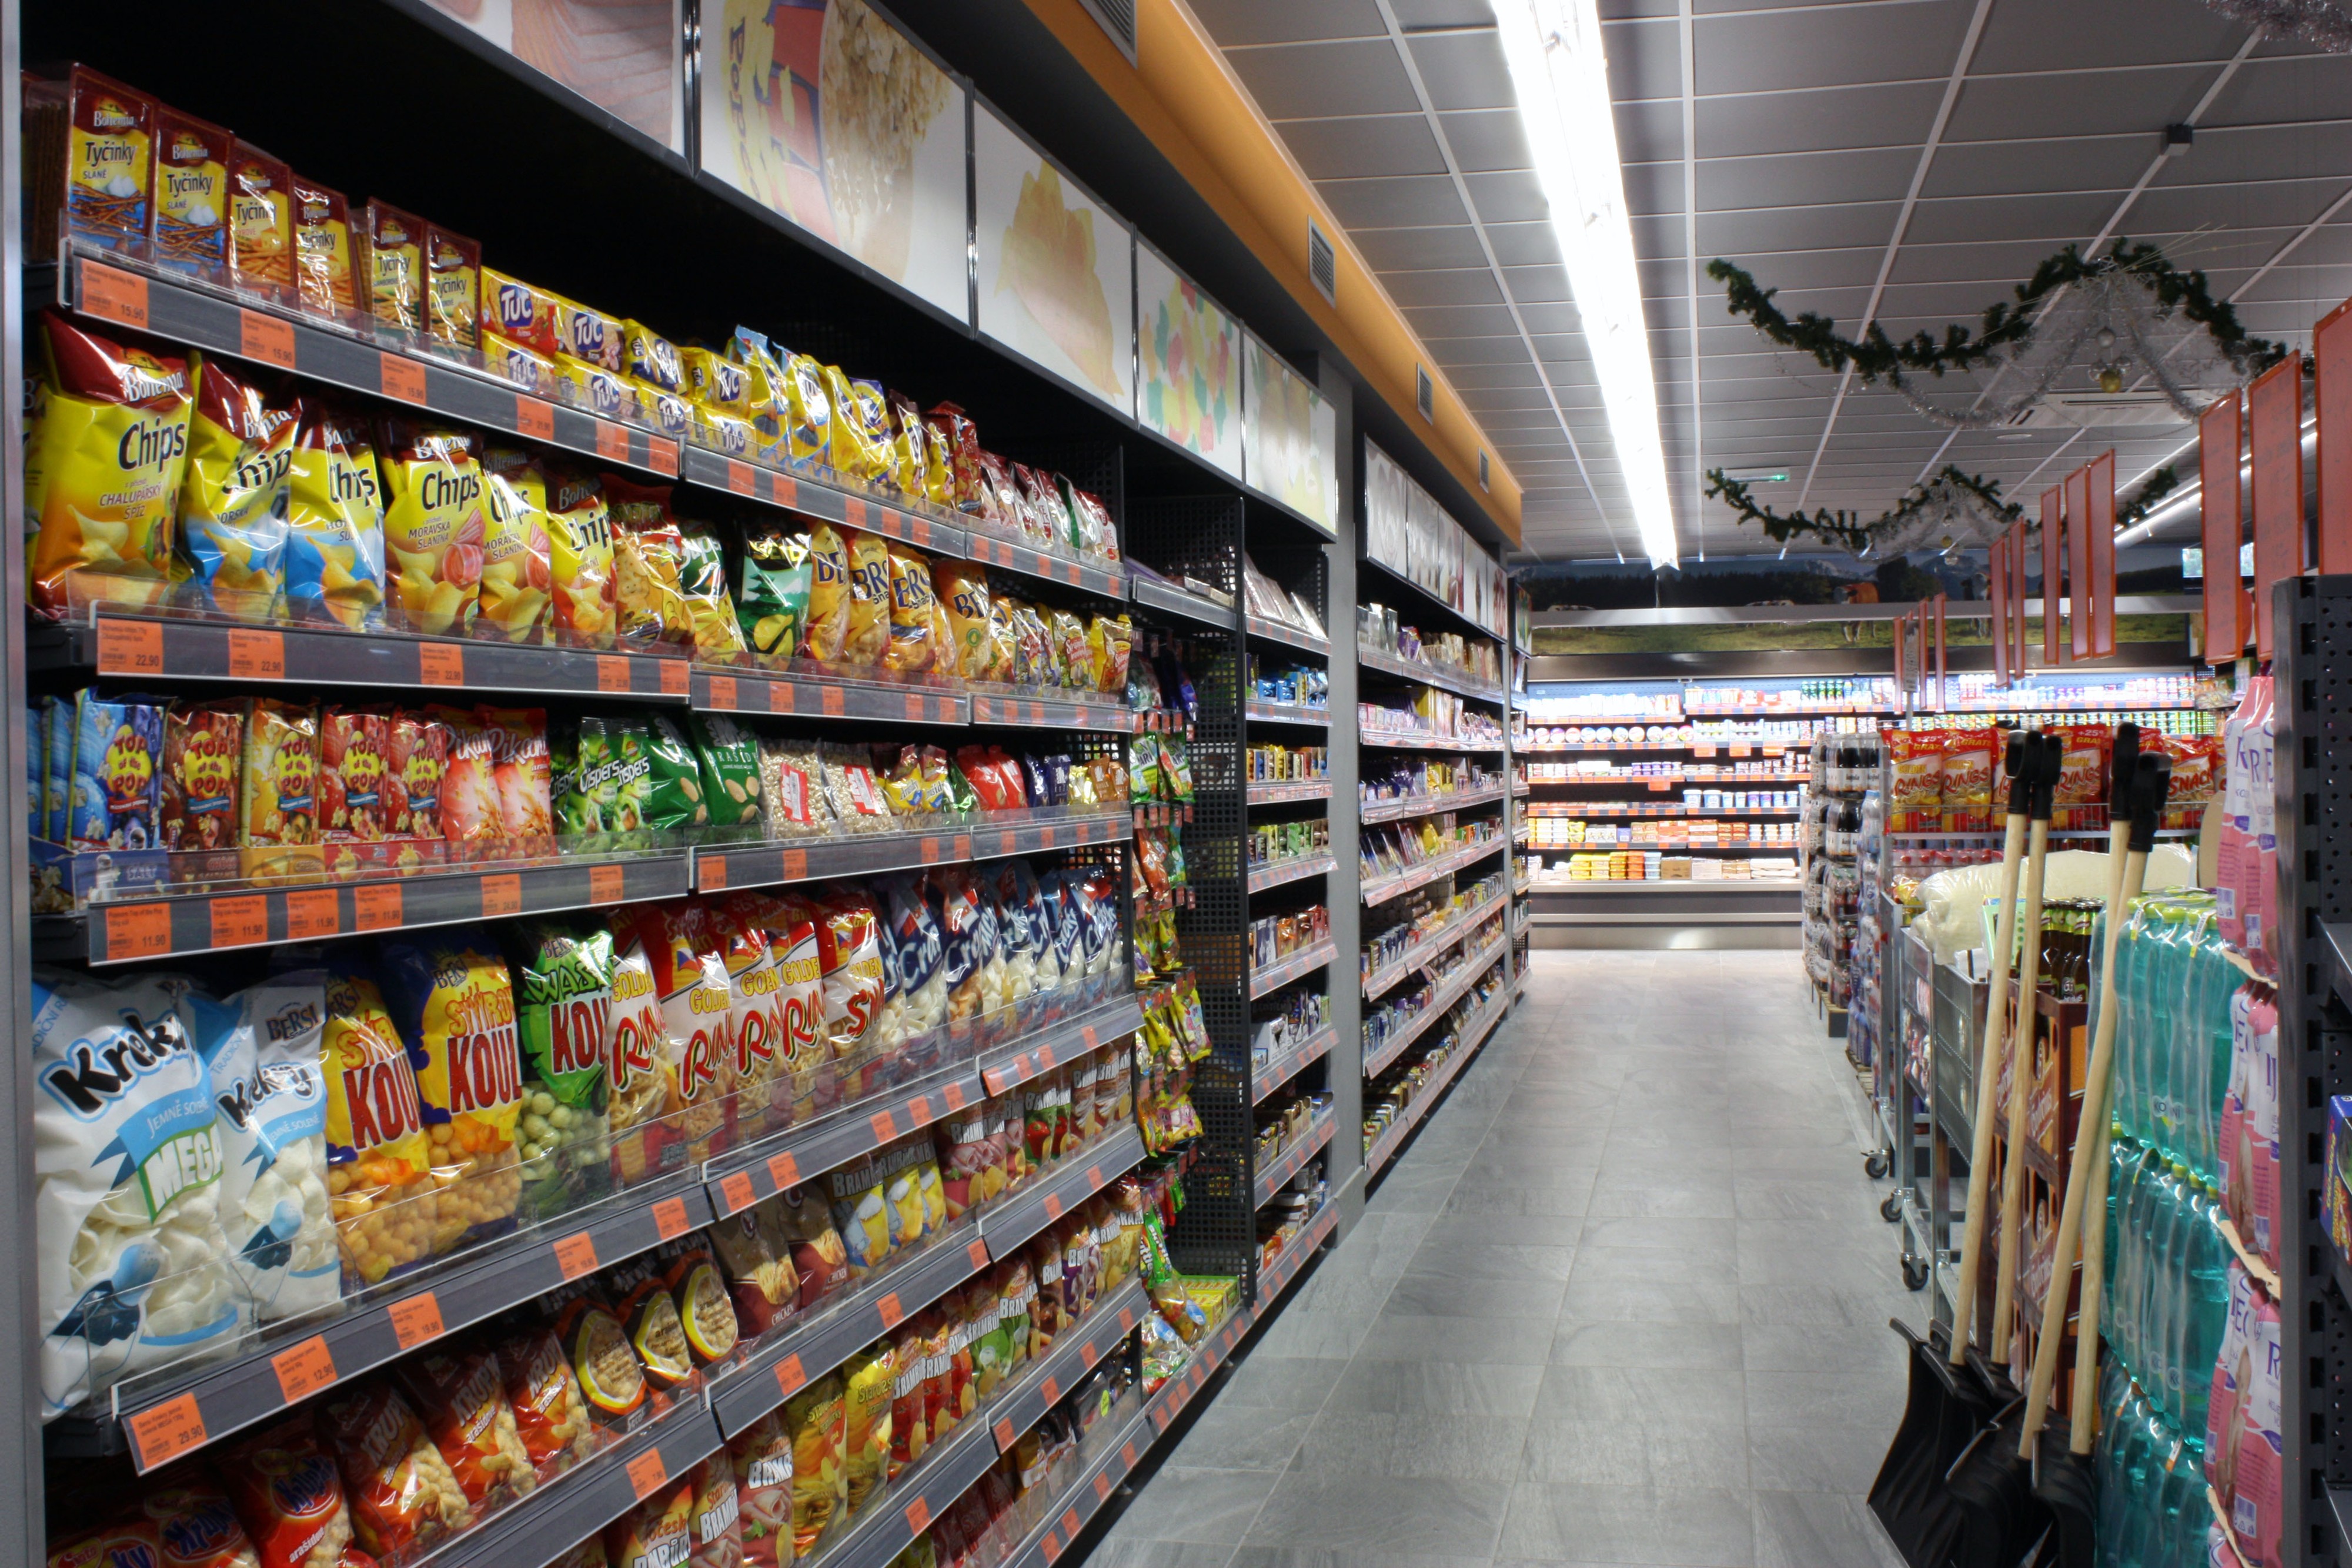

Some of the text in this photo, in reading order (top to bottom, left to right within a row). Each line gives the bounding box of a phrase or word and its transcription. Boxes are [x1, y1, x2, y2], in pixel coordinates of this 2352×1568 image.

[85, 141, 136, 167] Tyčinky
[83, 169, 107, 179] SLANÉ
[166, 172, 213, 198] Tyčinky
[236, 202, 277, 225] Tyčiny
[121, 303, 145, 321] 15.90
[500, 289, 532, 322] TUC
[574, 316, 603, 346] TUC
[273, 347, 293, 363] 15.90
[509, 356, 537, 386] TUC
[593, 382, 621, 410] TUC
[118, 417, 186, 473] Chips
[422, 470, 480, 512] Chips
[135, 654, 159, 667] 22.90
[261, 661, 282, 672] 22.90
[112, 735, 147, 755] TOP
[190, 739, 228, 760] TOP
[280, 740, 310, 758] TOP
[350, 739, 376, 755] TOP
[119, 758, 141, 770] of the
[413, 747, 435, 763] TOP
[198, 762, 222, 774] of the
[112, 775, 147, 791] POP
[190, 777, 230, 795] POP
[280, 774, 310, 792] POP
[352, 771, 376, 787] POP
[413, 778, 435, 793] POP
[1894, 768, 1940, 797] RINGS
[1943, 766, 1990, 795] RINGS
[2056, 765, 2102, 794] RINGS
[243, 924, 264, 935] 11.90
[142, 934, 166, 948] 11.90
[266, 1001, 319, 1042] BERSI
[143, 1122, 223, 1213] MEGA
[827, 1267, 847, 1284] CHICKEN
[771, 1304, 794, 1326] CHICKEN
[421, 1321, 440, 1335] 19.90
[313, 1363, 334, 1382] 12.90
[178, 1425, 203, 1445] 29.90
